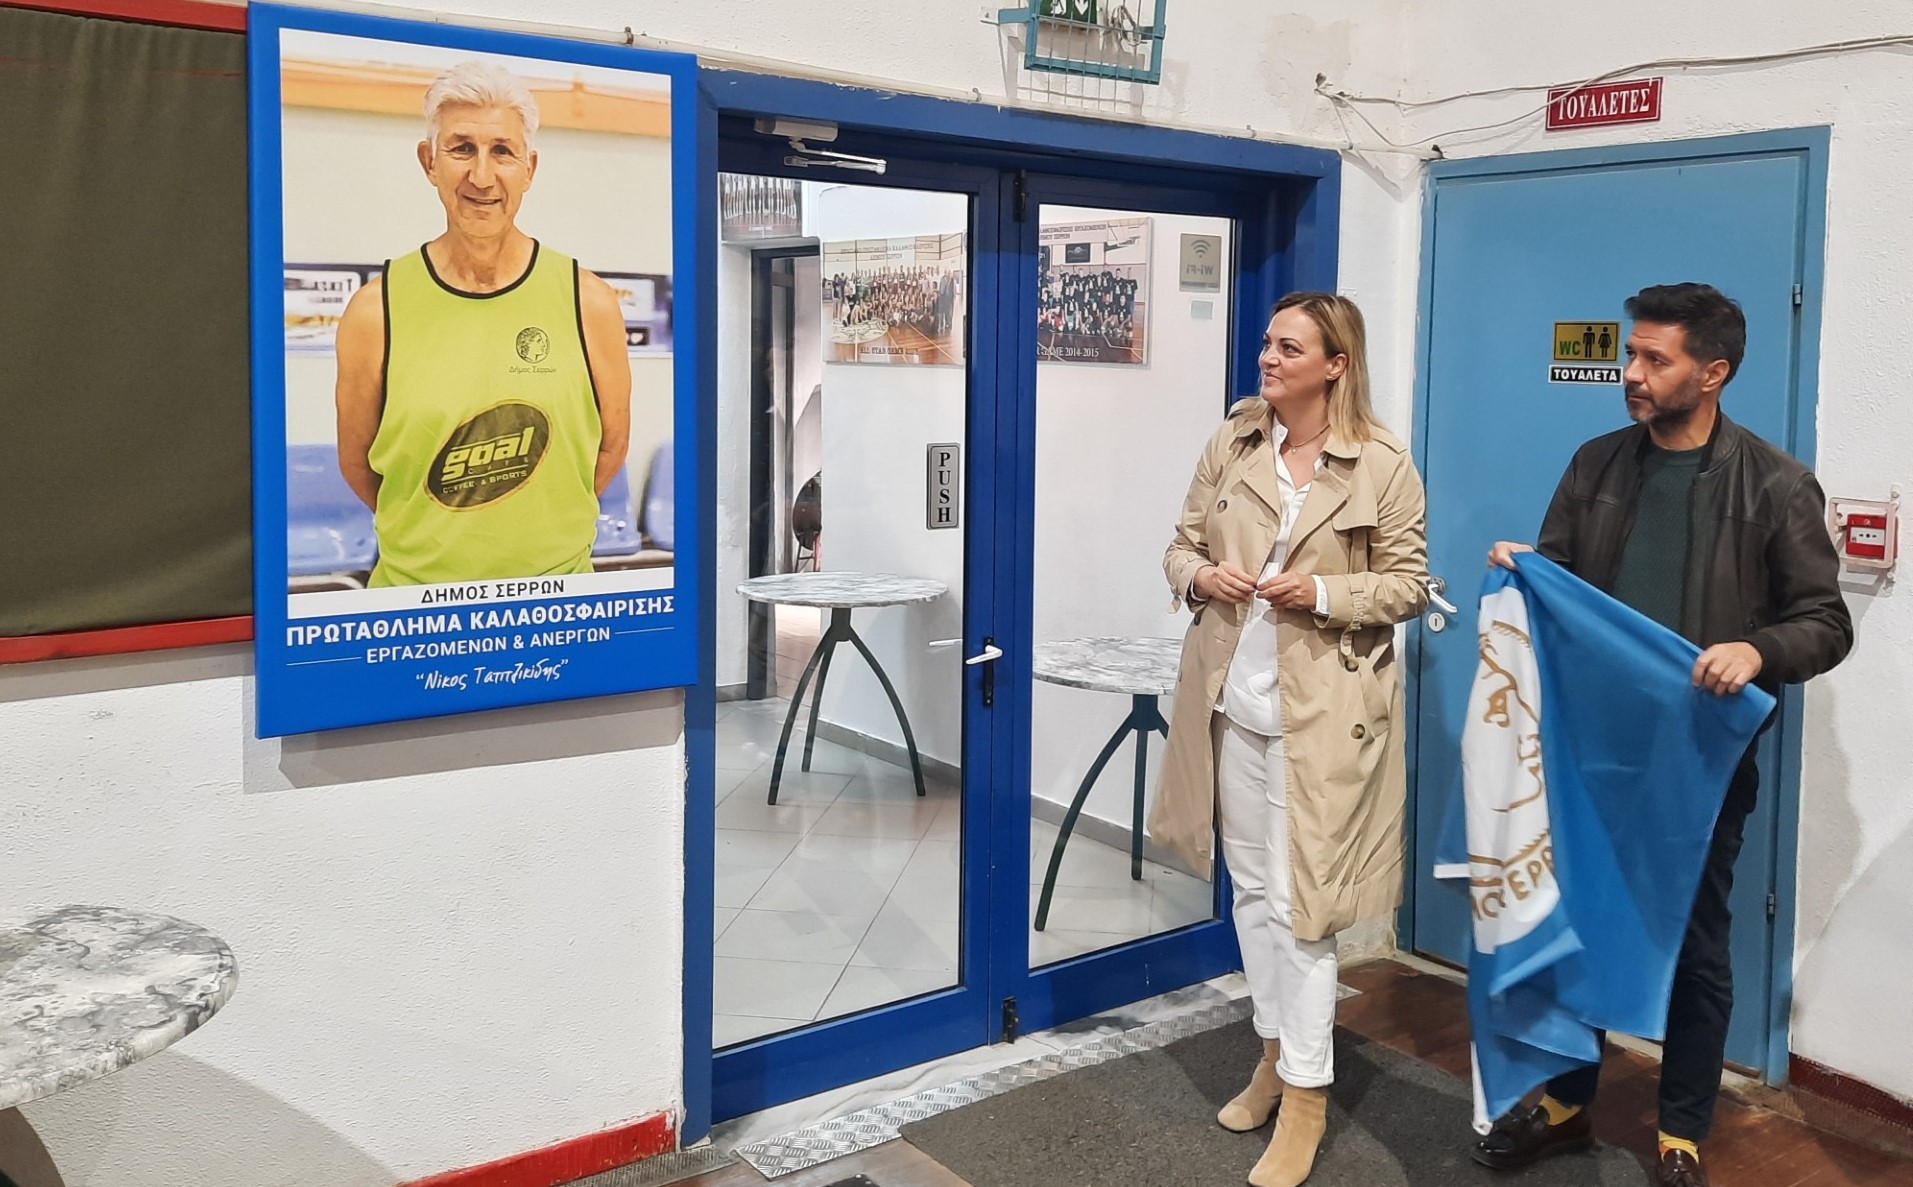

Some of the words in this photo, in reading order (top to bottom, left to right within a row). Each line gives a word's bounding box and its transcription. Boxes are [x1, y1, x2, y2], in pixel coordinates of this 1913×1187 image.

[1557, 88, 1650, 120] ΤΟΥΑΛΕΤΕΣ
[1065, 346, 1100, 358] 2014-2015
[1560, 340, 1580, 356] WC
[1554, 369, 1617, 381] ΤΟΥΑΛΕΤΑ
[441, 426, 535, 482] goal
[937, 452, 951, 523] PUSH
[421, 585, 489, 604] ΔΗΜΟΣ
[495, 579, 565, 598] ΣΕΡΡΩΝ
[286, 614, 463, 647] ΠΡΩΤΑΘΛΗΜΑ
[470, 595, 675, 630] ΚΑΛΑΘΟΣΦΑΙΡΙΣΗΣ
[366, 636, 507, 664] ΕΡΓΑΖΟΜΕΝΩΝ
[513, 634, 525, 650] &
[530, 626, 611, 648] ΑΝΕΡΓΩΝ
